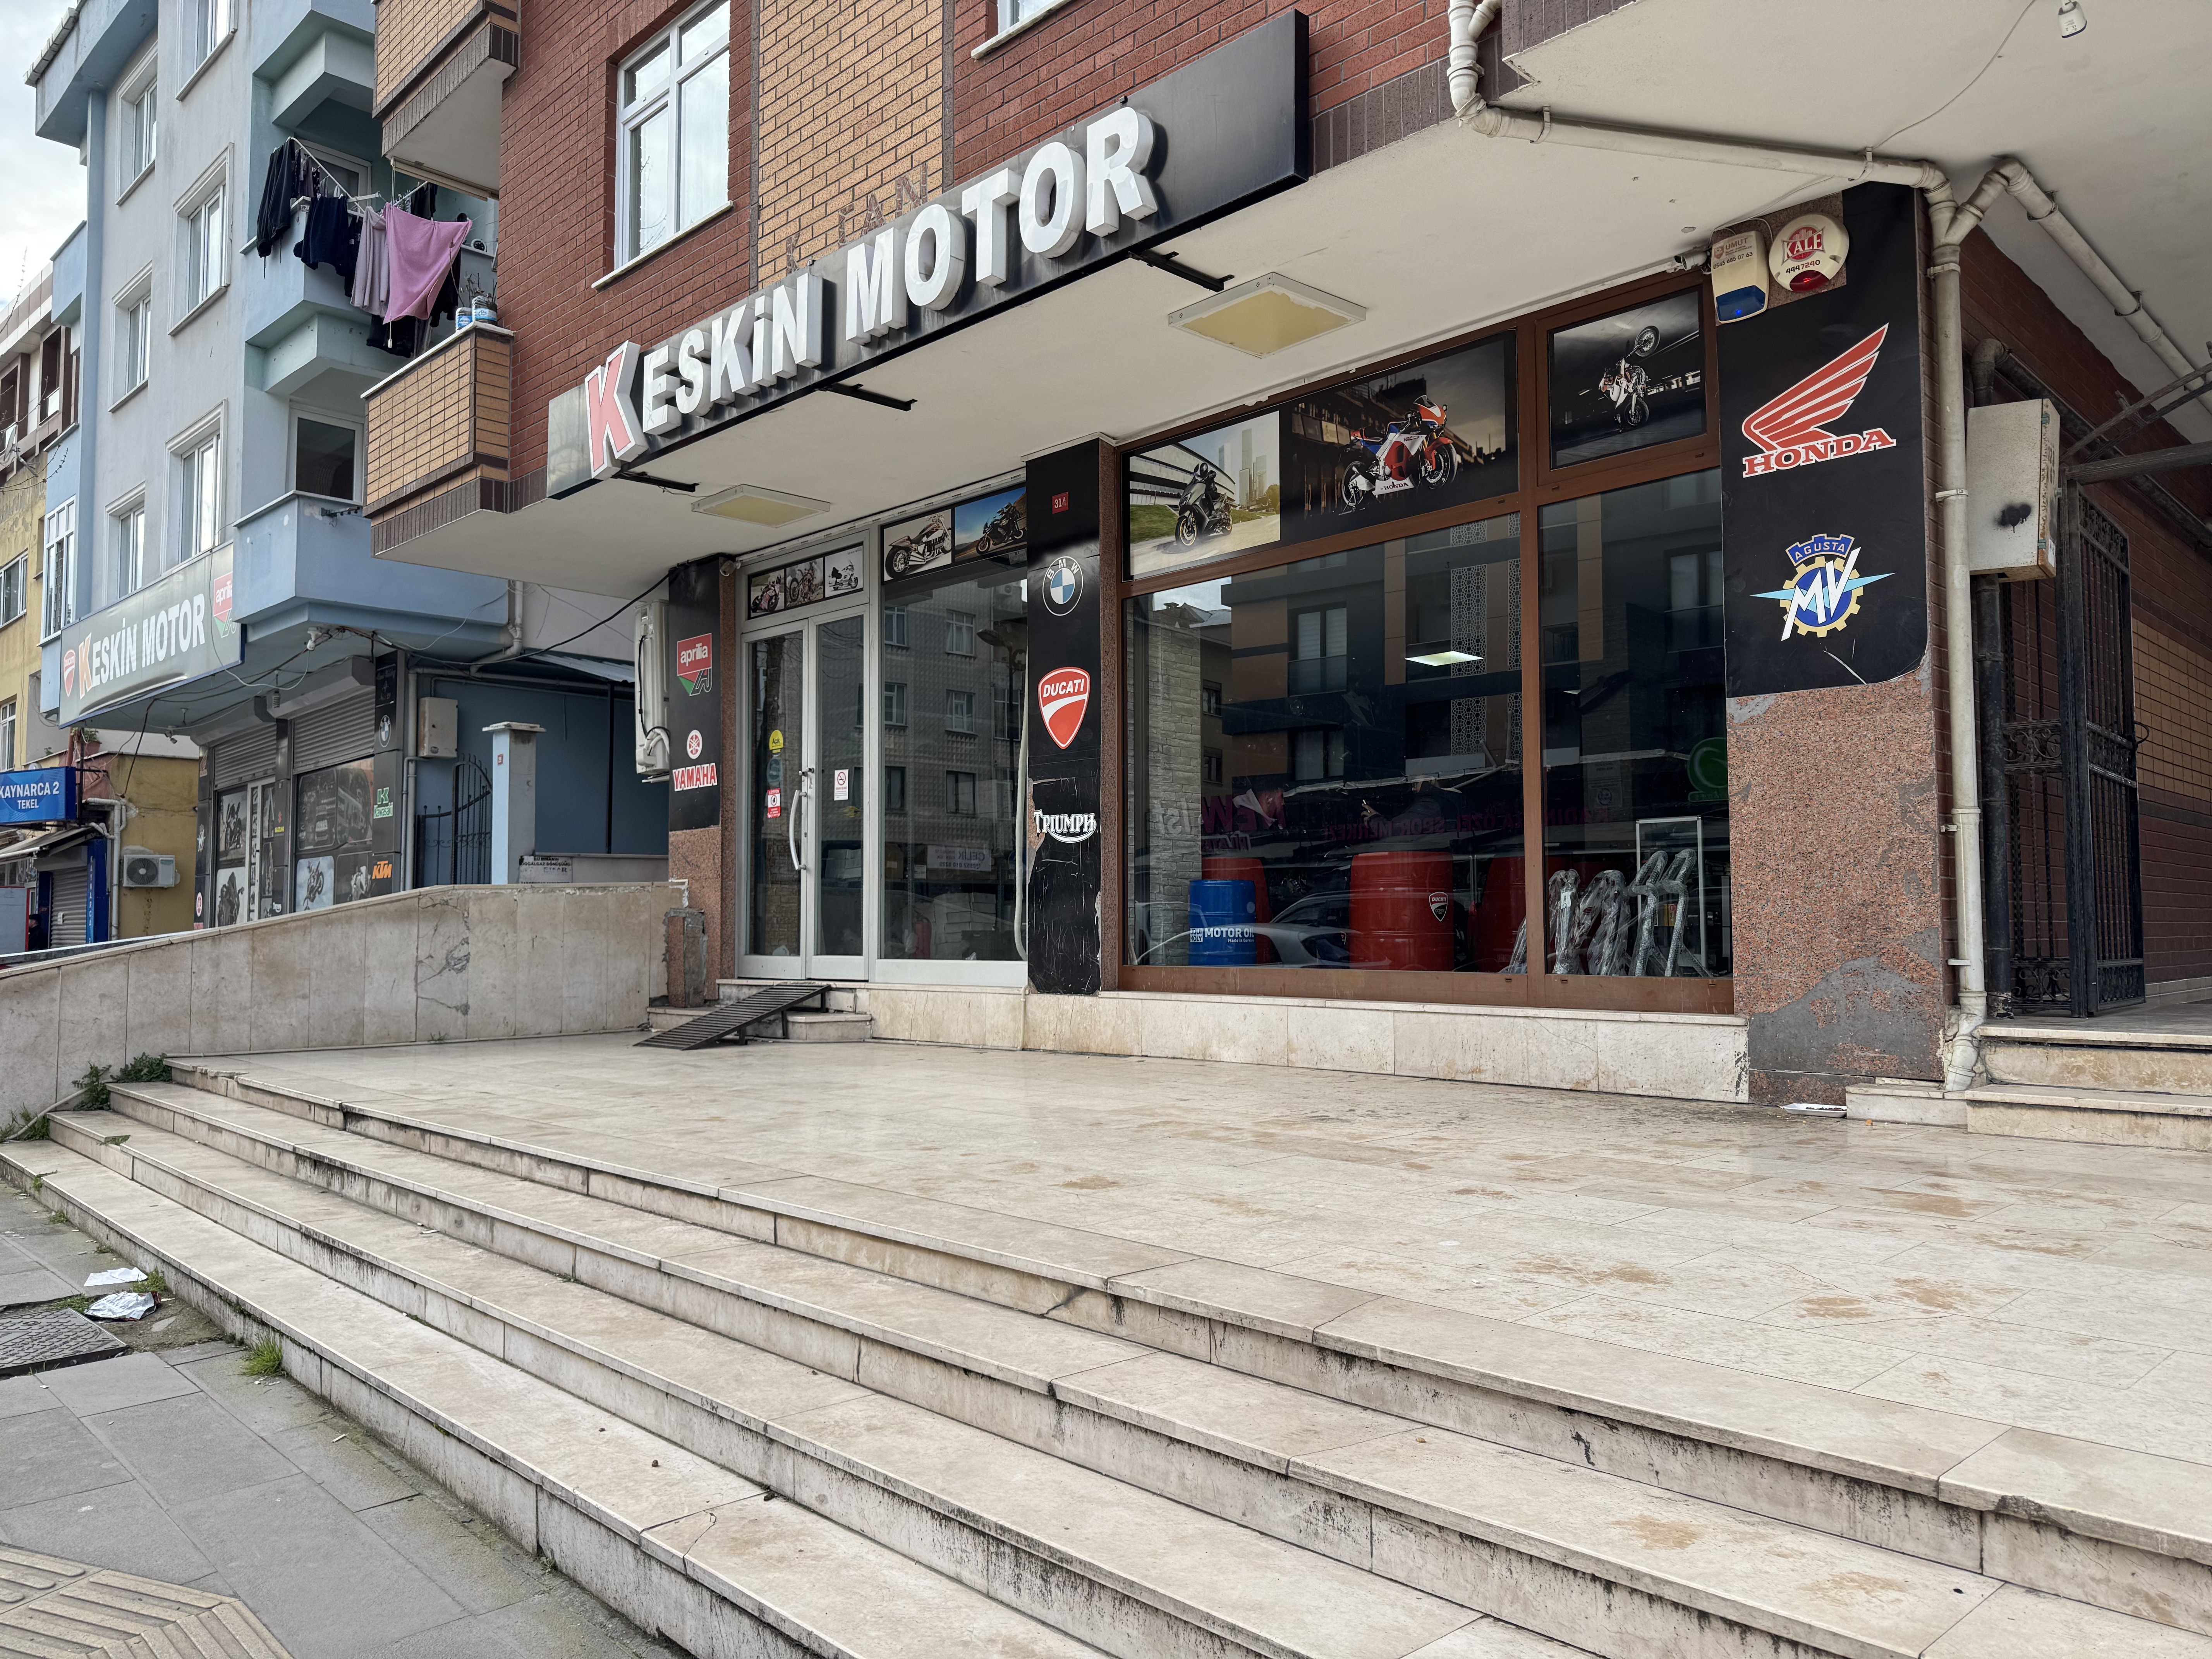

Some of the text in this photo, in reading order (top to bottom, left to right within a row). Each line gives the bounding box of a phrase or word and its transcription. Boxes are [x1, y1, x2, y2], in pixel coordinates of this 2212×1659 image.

[845, 106, 1157, 345] MOTOR
[1726, 237, 1748, 250] UMUT
[1784, 230, 1823, 262] KALE
[1713, 260, 1725, 269] 0545
[1743, 428, 1897, 478] HONDA
[1383, 482, 1409, 490] HONDA
[1795, 542, 1846, 561] AGUSTA
[1046, 558, 1080, 580] BMW
[216, 581, 232, 606] aprili
[142, 593, 205, 668] MOTOR
[680, 643, 708, 666] aprilia
[1043, 678, 1085, 697] DUCATI
[672, 763, 718, 792] YAMAHA
[0, 781, 59, 799] KAYNARCA 2
[17, 799, 39, 809] TEKEL
[1033, 809, 1097, 834] TRIUMPH
[372, 860, 392, 879] KTM
[1205, 928, 1254, 938] MOTOR OIL
